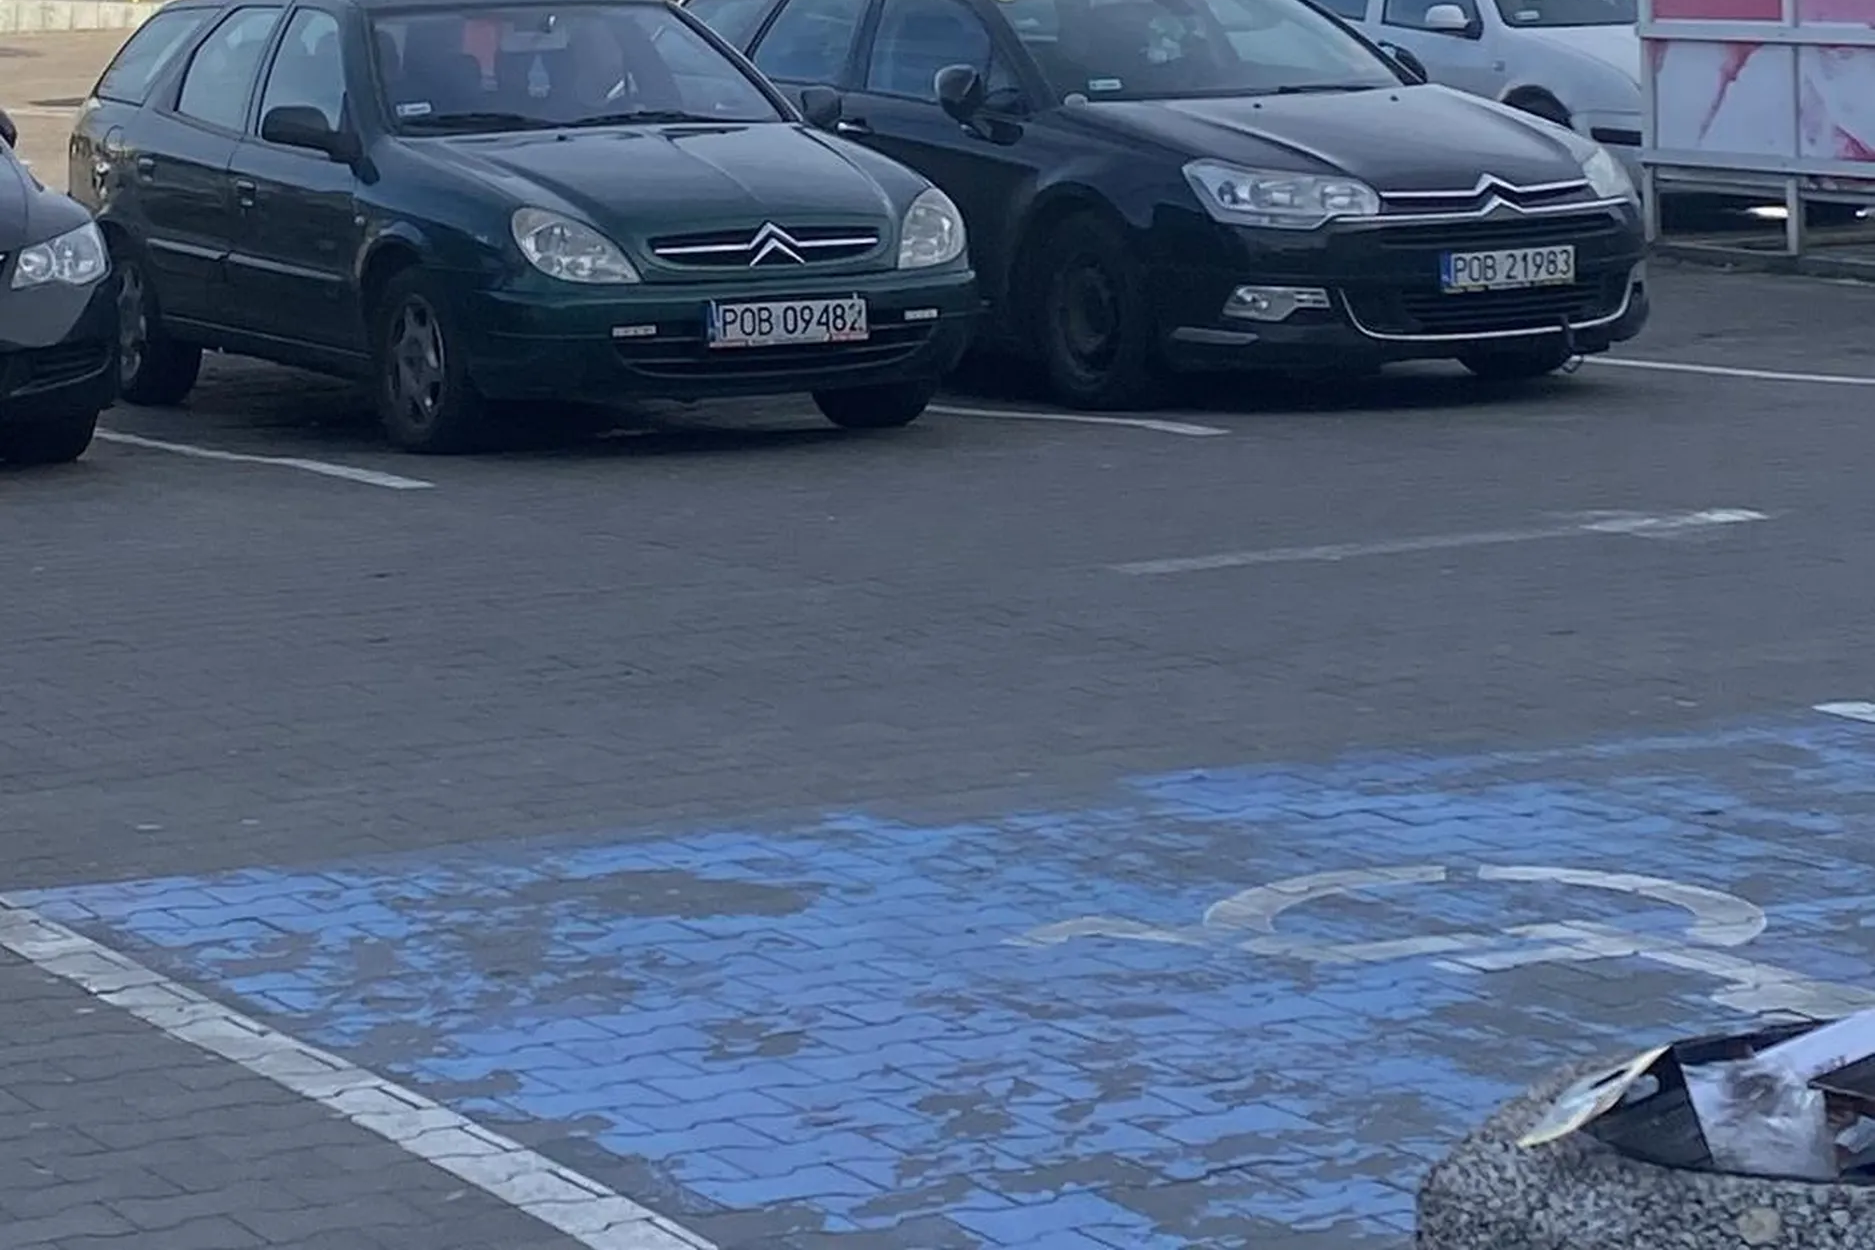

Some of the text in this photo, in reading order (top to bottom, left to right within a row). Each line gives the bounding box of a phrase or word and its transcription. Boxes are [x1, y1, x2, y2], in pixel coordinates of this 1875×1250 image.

[1453, 254, 1498, 283] POB
[721, 303, 864, 338] POB 09482
